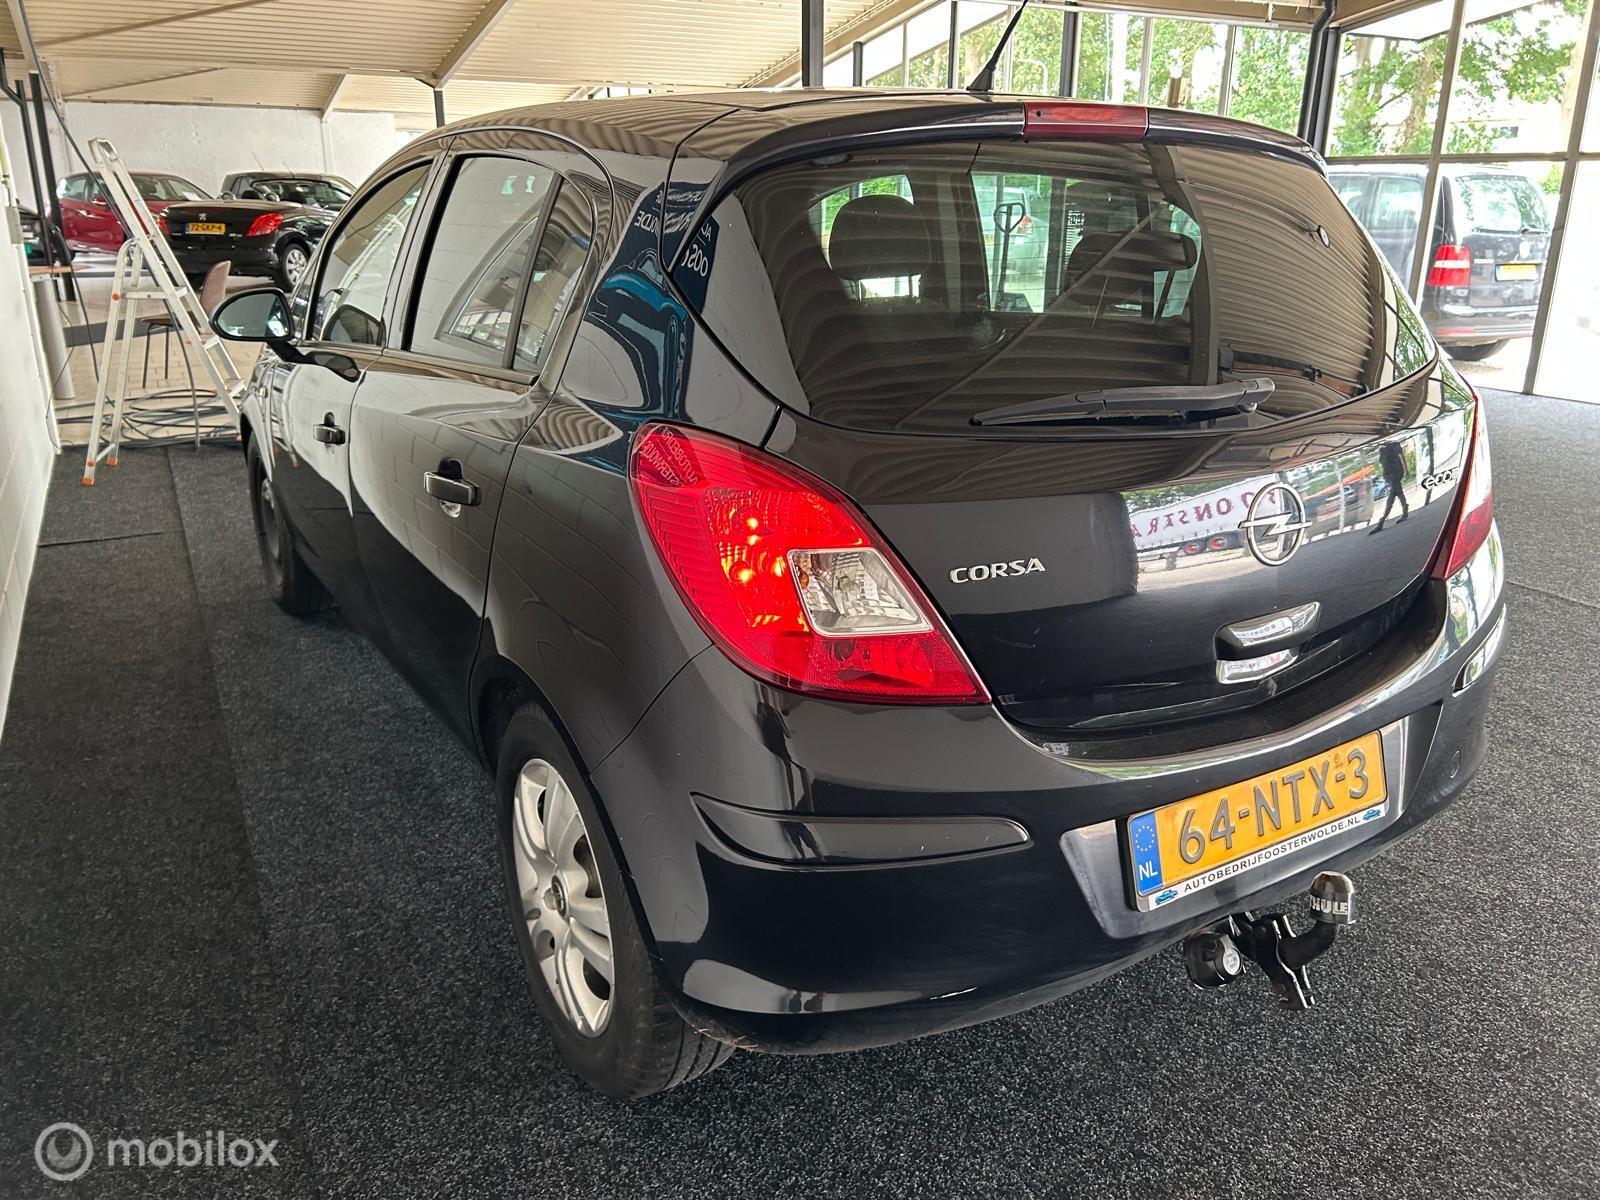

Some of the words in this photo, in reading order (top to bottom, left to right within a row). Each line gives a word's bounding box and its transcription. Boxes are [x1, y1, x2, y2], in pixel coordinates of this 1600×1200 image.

[949, 557, 1046, 584] CORSA
[1179, 748, 1369, 865] 64-NTX-3
[1138, 860, 1159, 881] NL
[1184, 816, 1361, 893] AUTOBEDRIJFOOSTERWOLDE.NL
